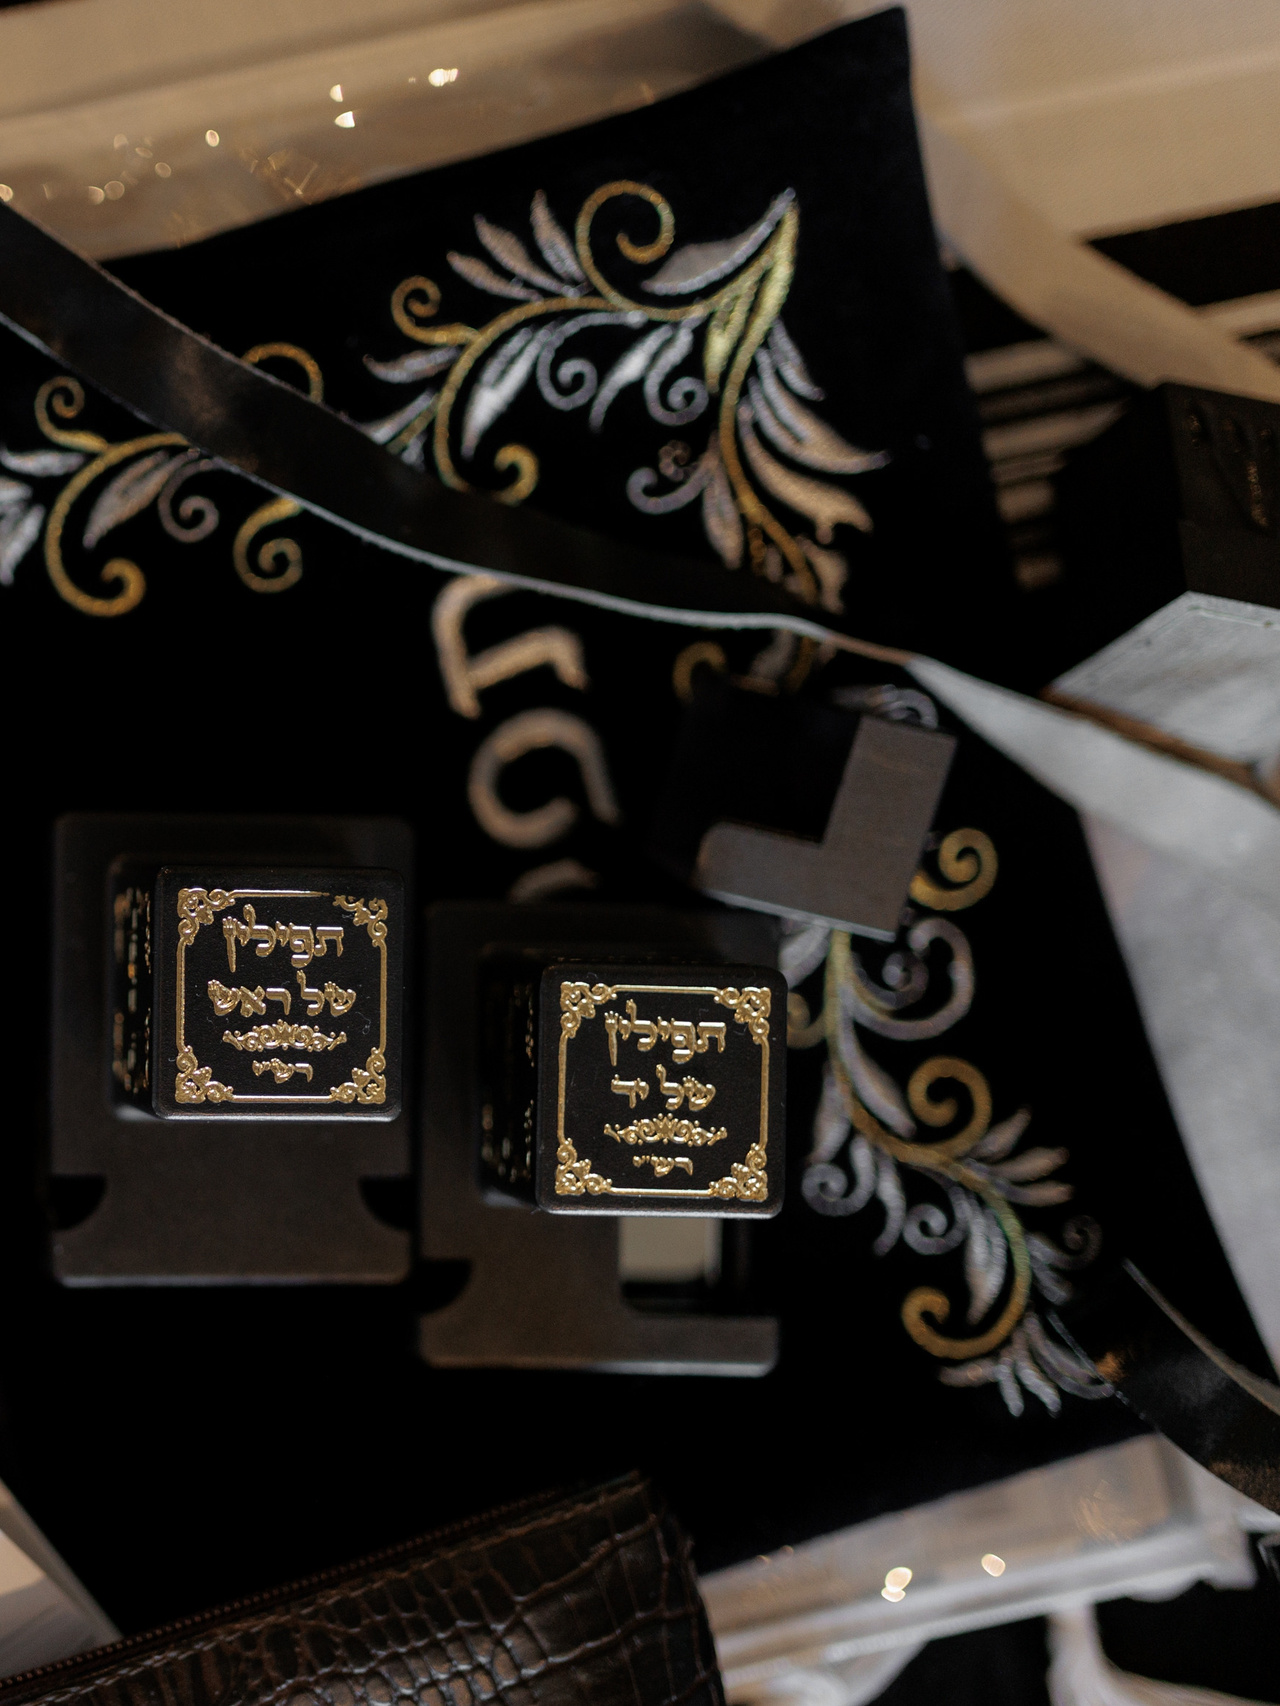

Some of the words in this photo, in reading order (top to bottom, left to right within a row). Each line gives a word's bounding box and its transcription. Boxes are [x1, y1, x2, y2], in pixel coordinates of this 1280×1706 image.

[222, 903, 344, 973] תפילין
[207, 978, 292, 1018] ראש
[295, 969, 357, 1017] של
[603, 998, 727, 1067] תפילין
[610, 1073, 650, 1109] יד
[655, 1063, 717, 1112] של
